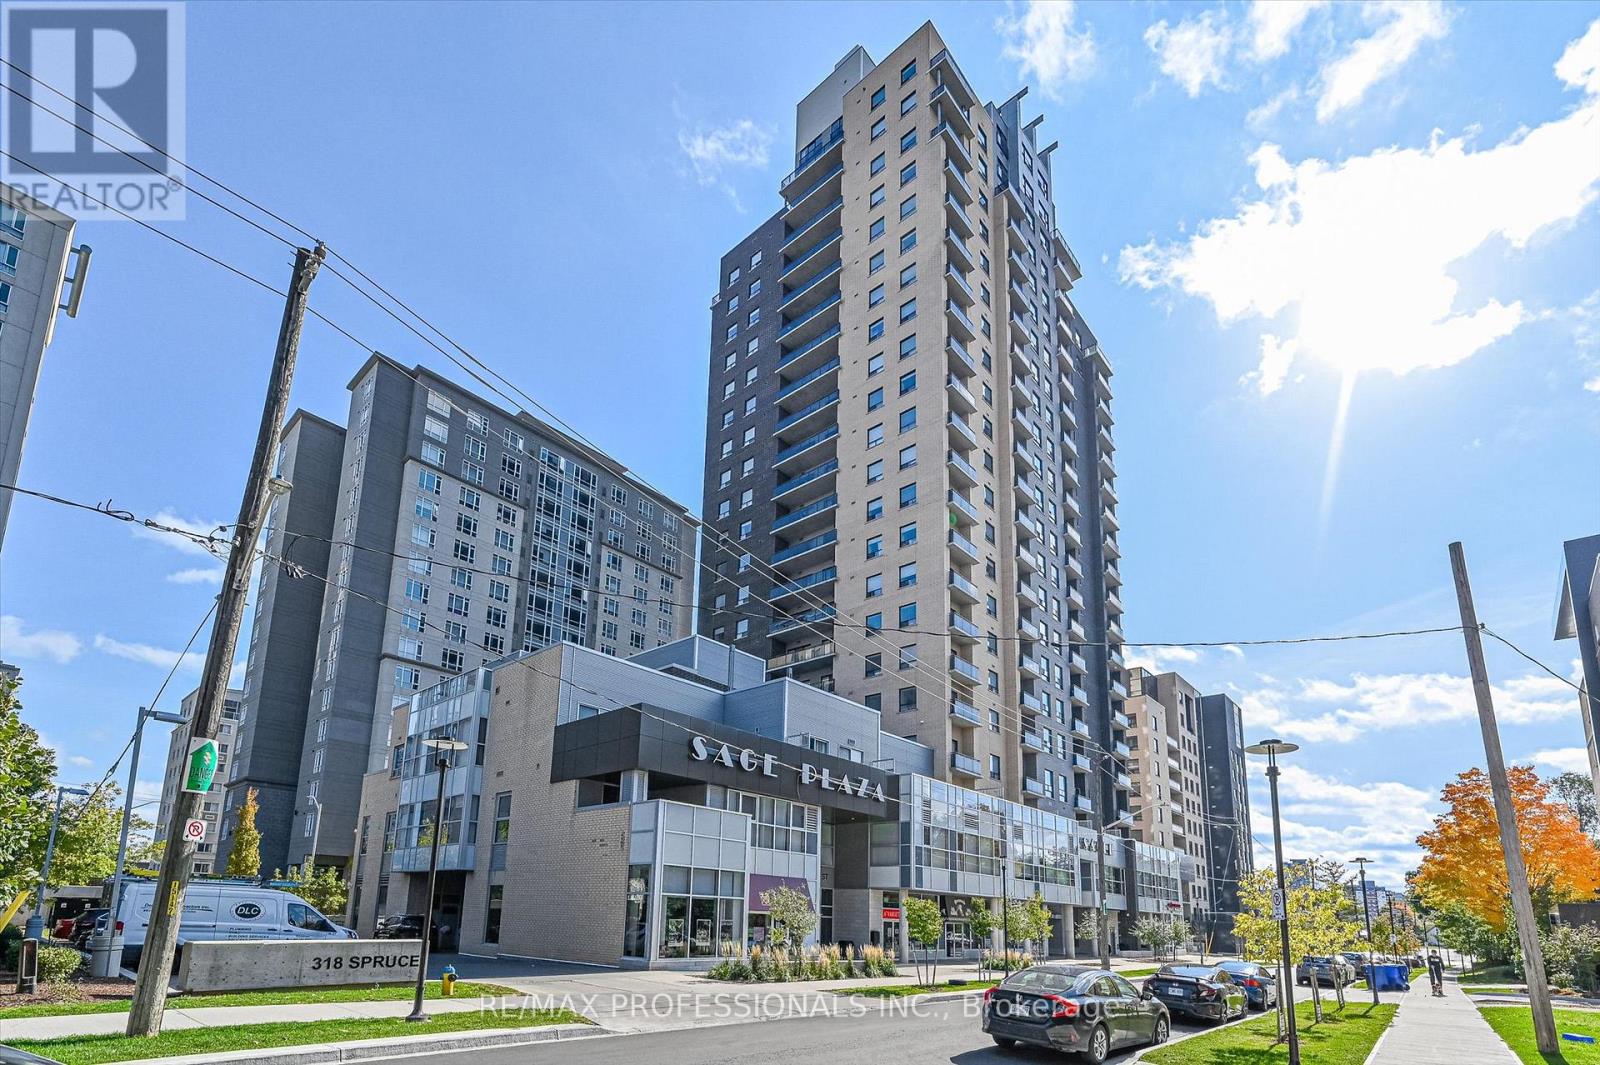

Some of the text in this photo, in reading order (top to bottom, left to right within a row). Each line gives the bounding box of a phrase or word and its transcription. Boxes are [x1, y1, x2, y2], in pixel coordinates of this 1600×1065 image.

[691, 736, 886, 803] SAGE PLAZA
[237, 906, 259, 915] DLC
[312, 955, 419, 970] 318 SPRUCE
